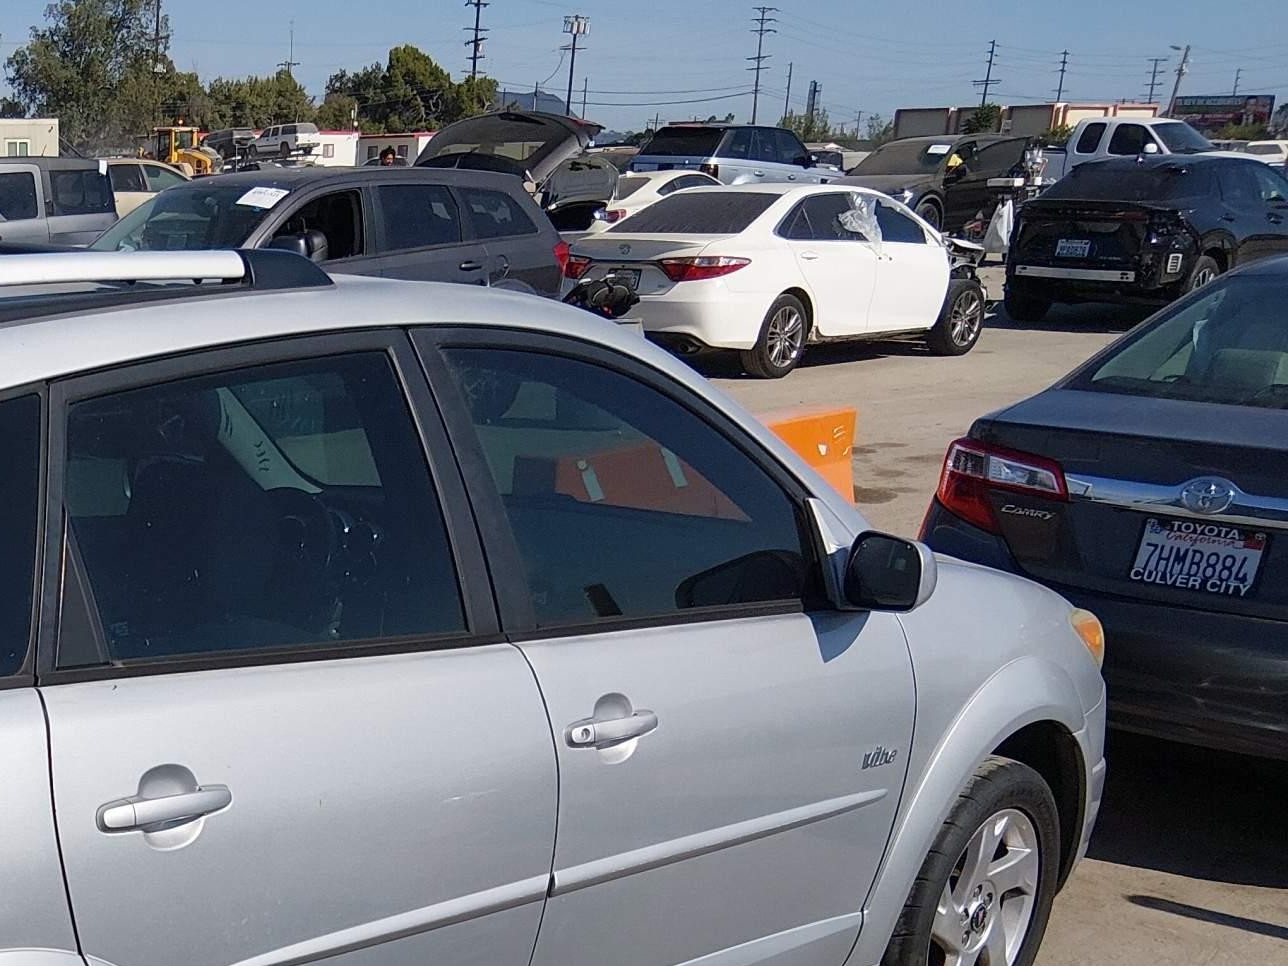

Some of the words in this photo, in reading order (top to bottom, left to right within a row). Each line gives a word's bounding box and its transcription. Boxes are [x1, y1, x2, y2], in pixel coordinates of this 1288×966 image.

[1171, 520, 1240, 540] TOYOTA
[1143, 542, 1248, 584] 7HMB884
[1130, 567, 1202, 590] CULVER
[1206, 578, 1252, 597] CITY
